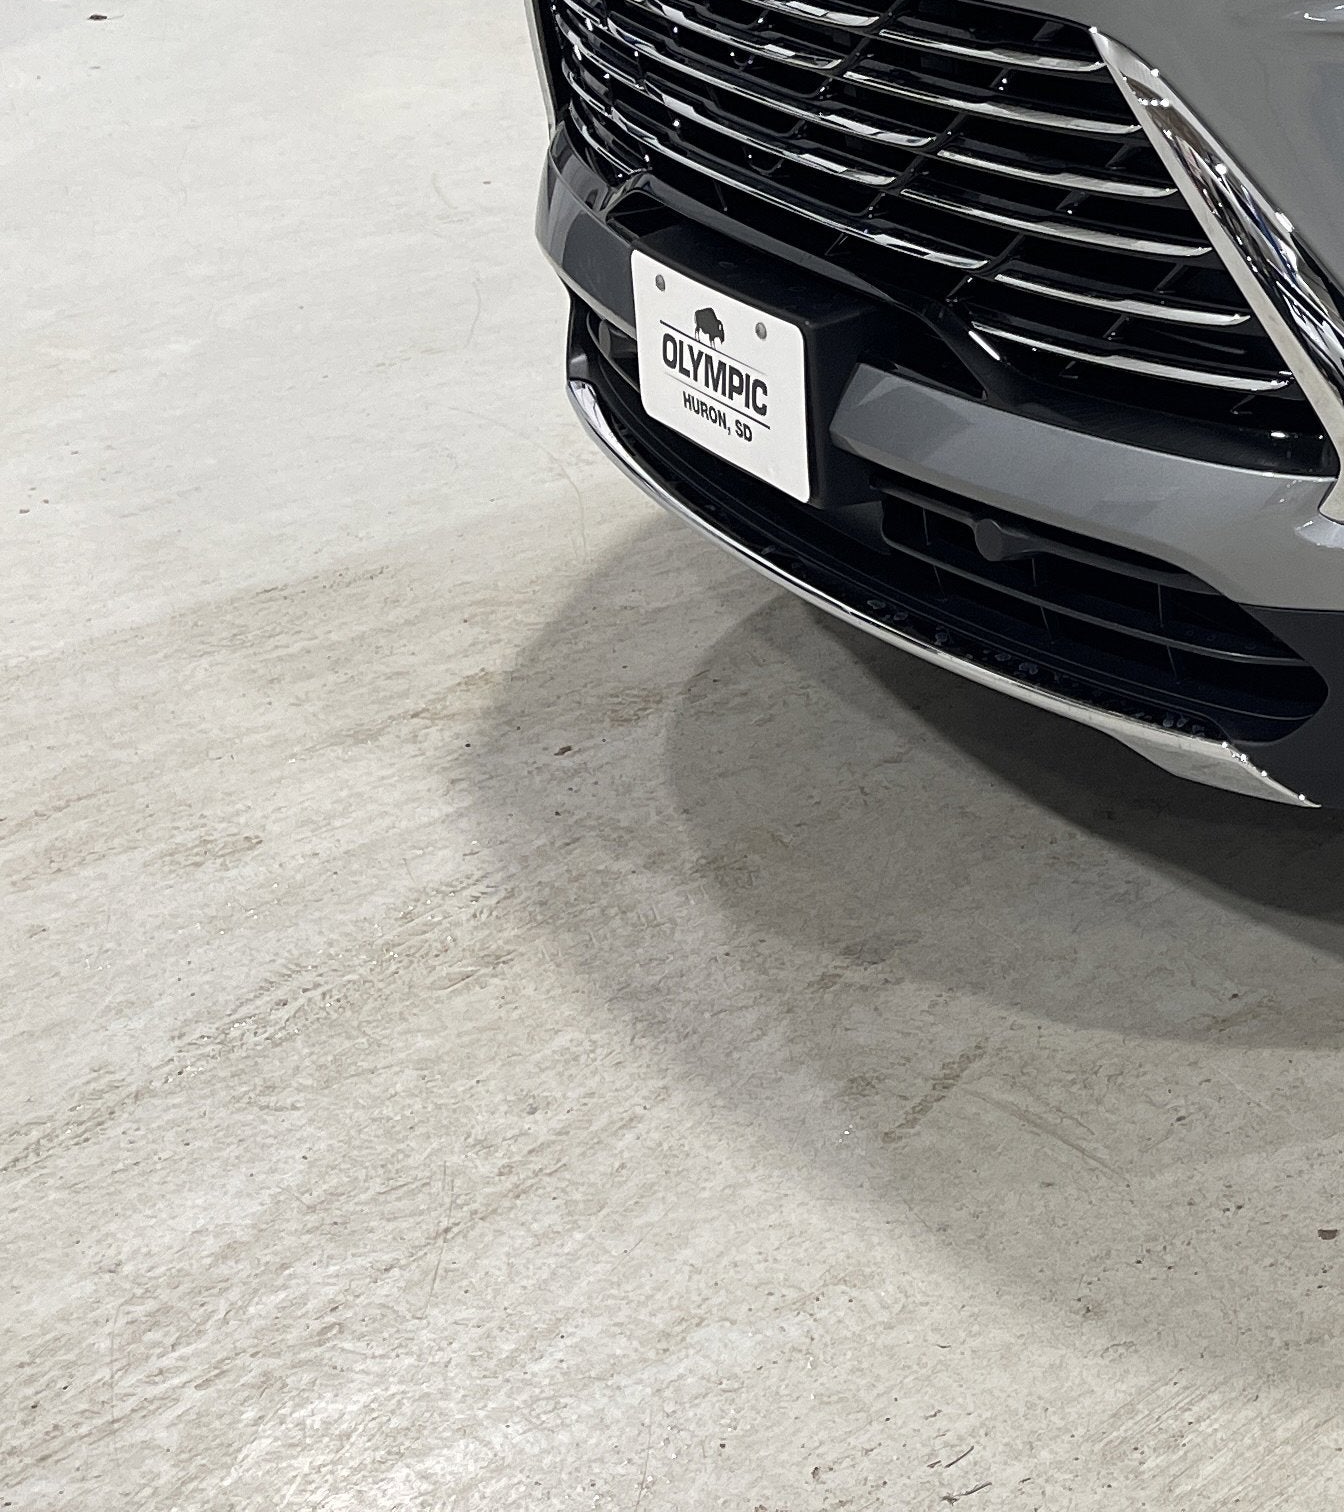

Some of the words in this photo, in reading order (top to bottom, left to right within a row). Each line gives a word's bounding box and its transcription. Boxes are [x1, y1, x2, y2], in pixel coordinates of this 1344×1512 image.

[661, 332, 768, 417] OLYMPIC
[682, 390, 732, 436] HURON,
[735, 418, 753, 443] SD
